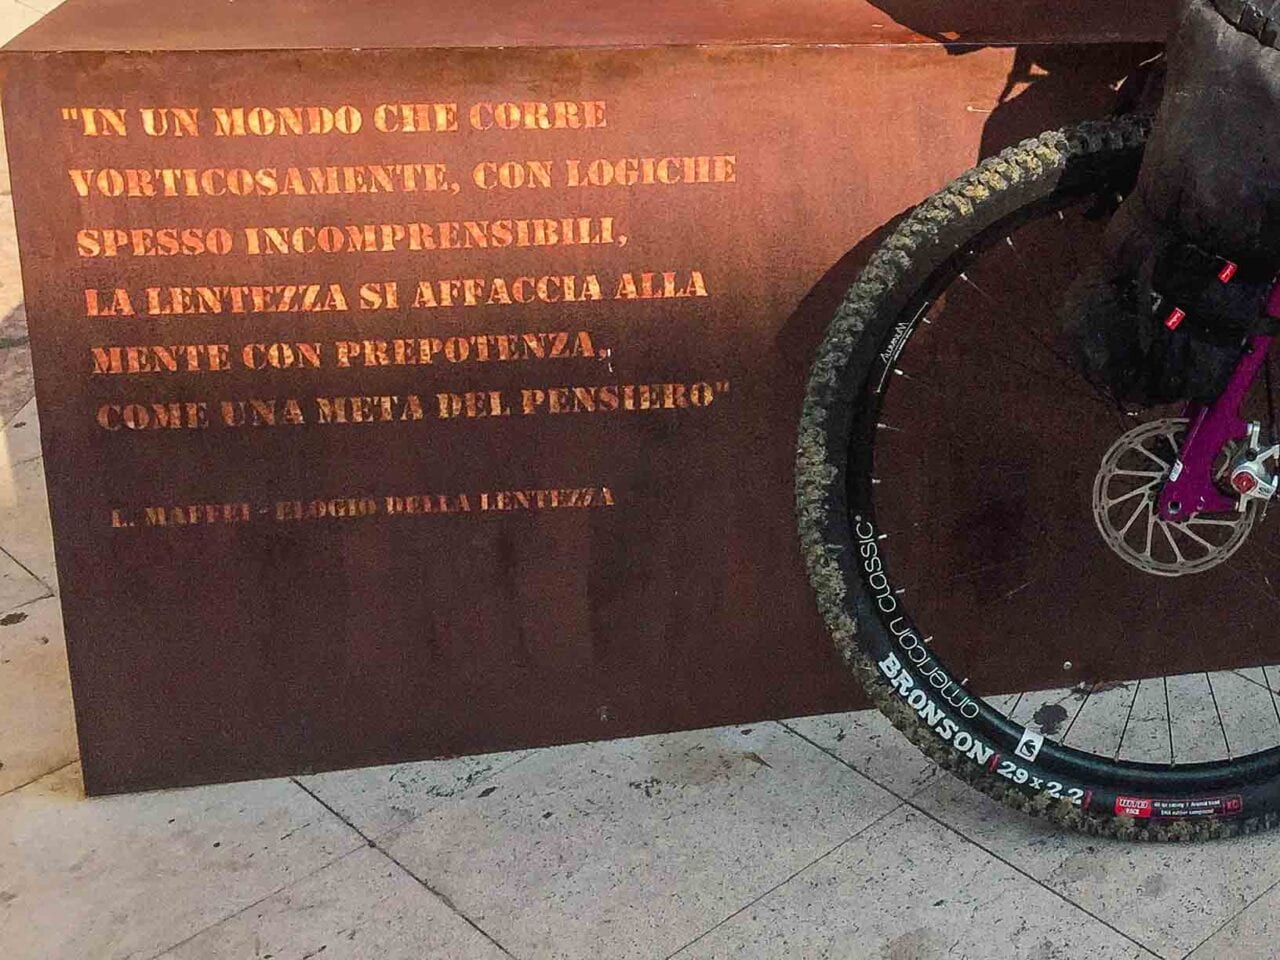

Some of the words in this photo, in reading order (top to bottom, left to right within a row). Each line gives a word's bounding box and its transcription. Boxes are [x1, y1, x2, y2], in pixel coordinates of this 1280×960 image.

[62, 108, 127, 135] "IN
[139, 109, 197, 135] UN
[213, 106, 361, 135] MONDO
[375, 104, 457, 131] CHE
[470, 101, 606, 129] CORRE
[69, 164, 459, 196] VORTICOSAMENTE,
[474, 161, 552, 188] CON
[566, 156, 735, 186] LOGICHE
[77, 229, 232, 257] SPESSO
[245, 217, 627, 254] INCOMPRENSIBILI,
[85, 289, 134, 316] LA
[147, 285, 347, 314] LENTEZZA
[360, 283, 397, 309] SI
[413, 275, 602, 307] AFFACCIA
[616, 272, 707, 299] ALLA
[92, 345, 230, 373] MENTE
[243, 343, 320, 368] CON
[336, 332, 607, 366] PREPOTENZA,
[97, 403, 206, 429] COME
[221, 400, 304, 426] UNA
[317, 396, 423, 423] META
[437, 392, 510, 418] DEL
[277, 499, 376, 520] ELOGIO
[386, 495, 470, 514] DELLA
[481, 487, 614, 510] LENTEZZA
[889, 616, 980, 719] american
[877, 652, 995, 765] BRONSON
[997, 760, 1029, 785] 29
[1029, 776, 1044, 790] x
[1046, 781, 1084, 805] 2.2
